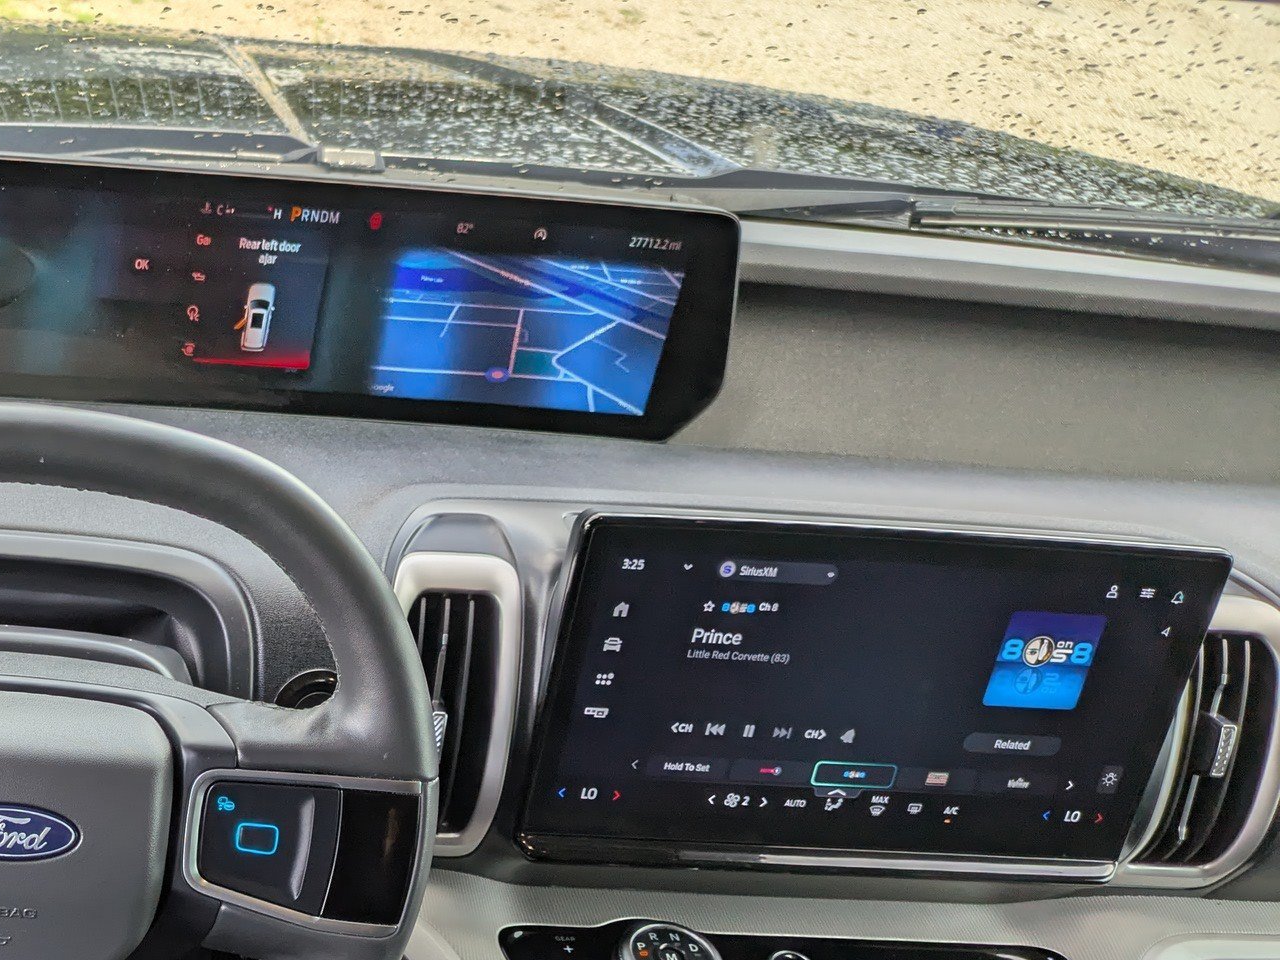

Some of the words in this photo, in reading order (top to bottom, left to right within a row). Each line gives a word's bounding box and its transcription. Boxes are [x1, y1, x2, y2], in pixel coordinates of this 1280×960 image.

[273, 208, 282, 220] H
[239, 237, 261, 250] Rear
[261, 238, 278, 251] left
[279, 240, 302, 253] door
[134, 258, 150, 271] OK
[258, 254, 278, 266] ajar
[621, 557, 646, 571] 3:25
[739, 565, 778, 578] SiriusXM
[758, 601, 770, 613] Ch
[771, 602, 779, 613] 8
[691, 627, 742, 647] Prince
[686, 649, 708, 661] Little
[709, 650, 726, 661] Red
[727, 651, 769, 663] Corvette
[770, 653, 790, 665] (83)
[1057, 640, 1074, 649] on
[1070, 642, 1093, 664] 8
[994, 738, 1031, 751] Related
[663, 761, 683, 772] Hold
[684, 762, 695, 772] To
[696, 763, 710, 773] Set
[580, 787, 598, 800] LO
[741, 795, 750, 806] 2
[784, 799, 807, 809] AUTO
[871, 795, 889, 805] MAX
[943, 805, 960, 816] A/C
[1064, 810, 1081, 823] LO
[648, 932, 659, 941] R
[669, 932, 680, 941] N
[636, 942, 646, 951] P
[688, 943, 699, 952] D
